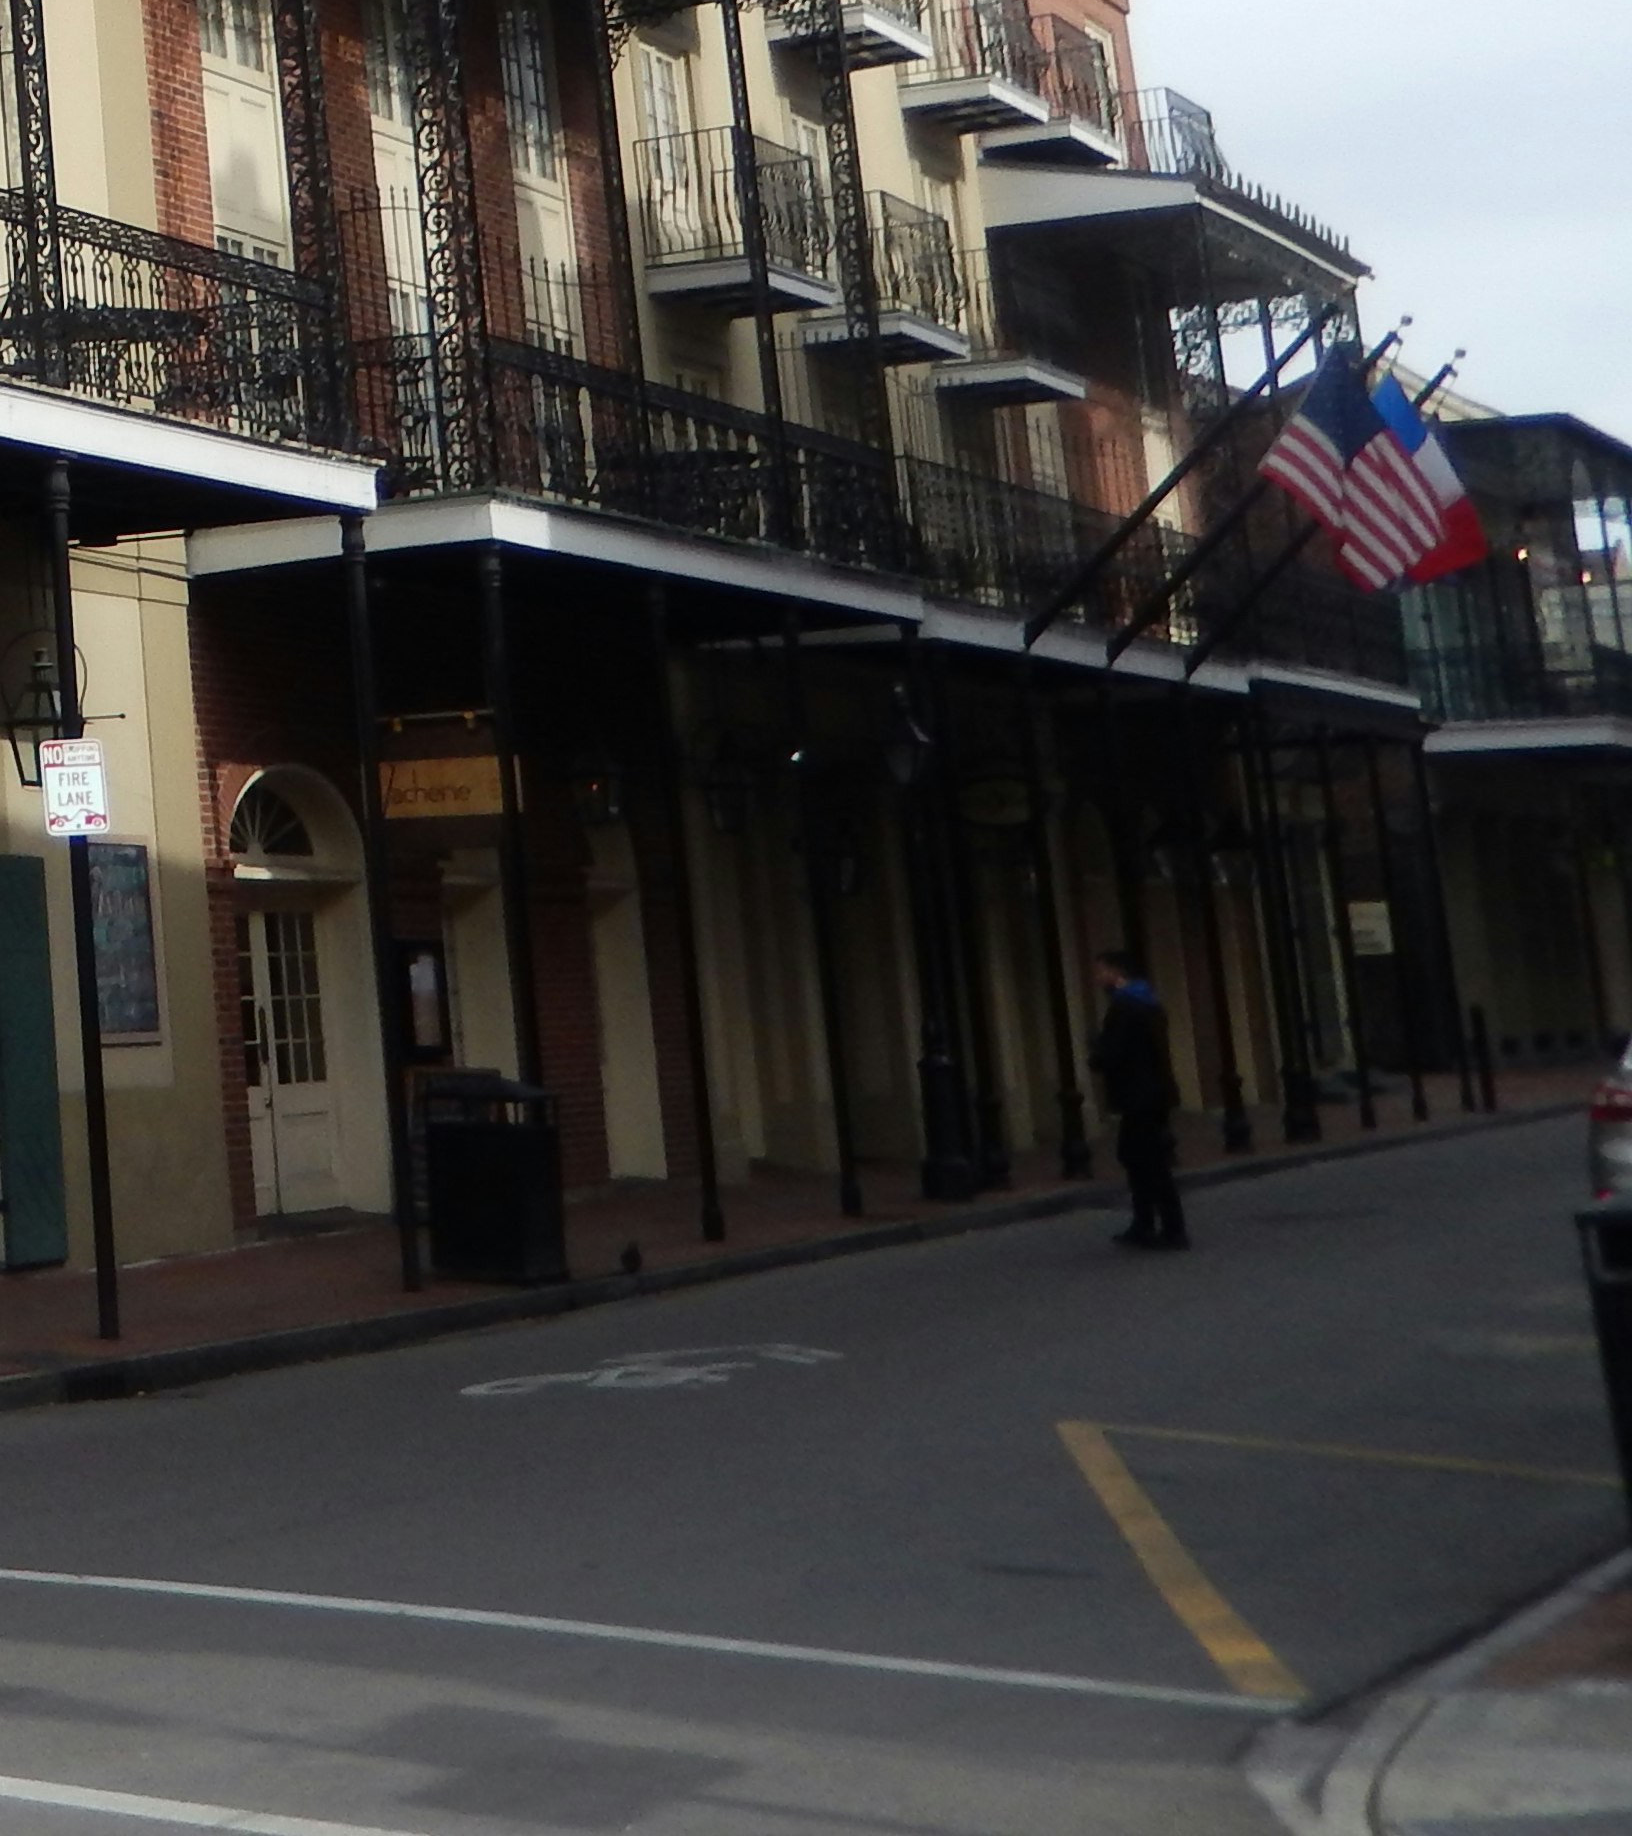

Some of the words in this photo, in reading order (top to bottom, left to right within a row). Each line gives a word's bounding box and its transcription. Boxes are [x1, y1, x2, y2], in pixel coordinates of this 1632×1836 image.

[43, 746, 64, 765] NO
[58, 771, 90, 787] FIRE
[57, 790, 95, 807] LANE
